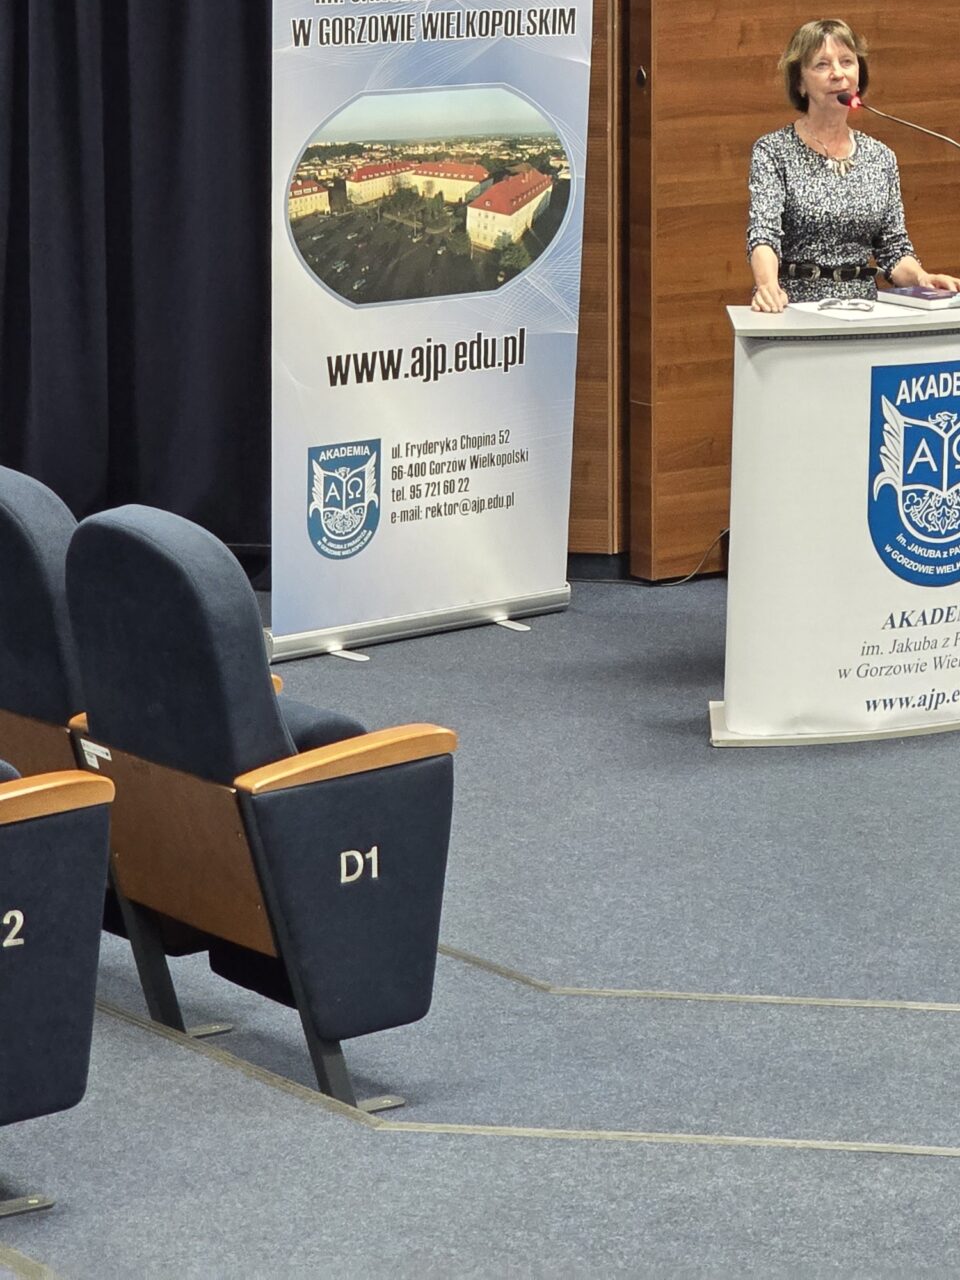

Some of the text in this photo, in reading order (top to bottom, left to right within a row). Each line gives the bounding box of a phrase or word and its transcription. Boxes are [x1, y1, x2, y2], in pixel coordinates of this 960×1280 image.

[291, 7, 576, 47] W GORZOWIE WIELKOPOLSKIM
[327, 328, 526, 388] www.ajp.edu.pl
[319, 445, 371, 462] AKADEMIA
[391, 429, 511, 459] ul. Fryderyka Chopina 52
[391, 461, 427, 481] 66-400
[469, 447, 530, 471] Wielkopolski
[391, 477, 471, 503] tel. 95 721 60 22
[390, 492, 516, 524] e-mail: rektor@ajp.edu.pl
[891, 549, 936, 575] GORZOWIE
[907, 542, 942, 559] JAKUBA
[860, 641, 885, 657] im.
[888, 635, 938, 655] Jakuba
[941, 636, 951, 649] z
[837, 668, 853, 680] w
[856, 659, 928, 679] Gorzowie
[340, 846, 380, 883] D1
[2, 909, 25, 948] 2
